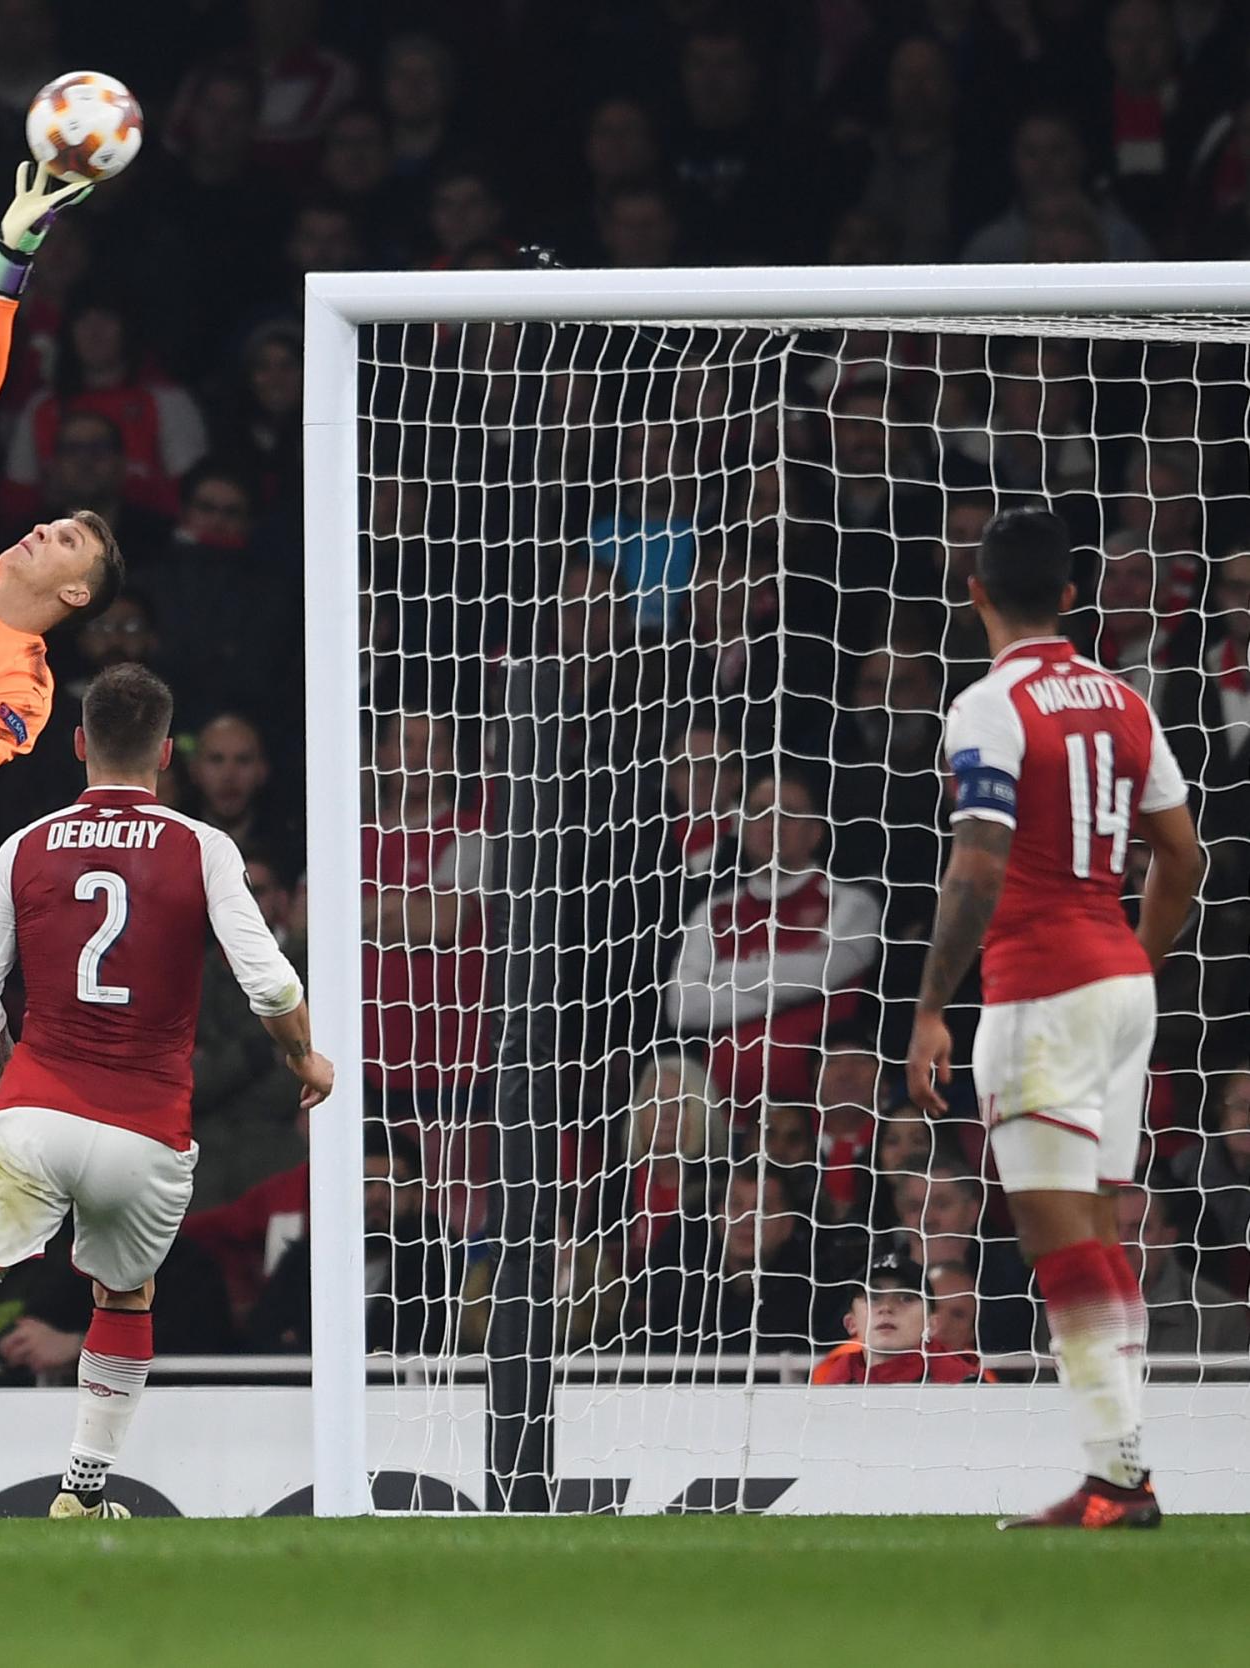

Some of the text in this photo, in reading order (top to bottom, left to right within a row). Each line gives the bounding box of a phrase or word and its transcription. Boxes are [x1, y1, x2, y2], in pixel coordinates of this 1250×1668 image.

[1025, 676, 1126, 716] WALCOTT
[46, 820, 166, 851] DEBUCHY
[1064, 731, 1133, 879] 14
[74, 870, 130, 1004] 2
